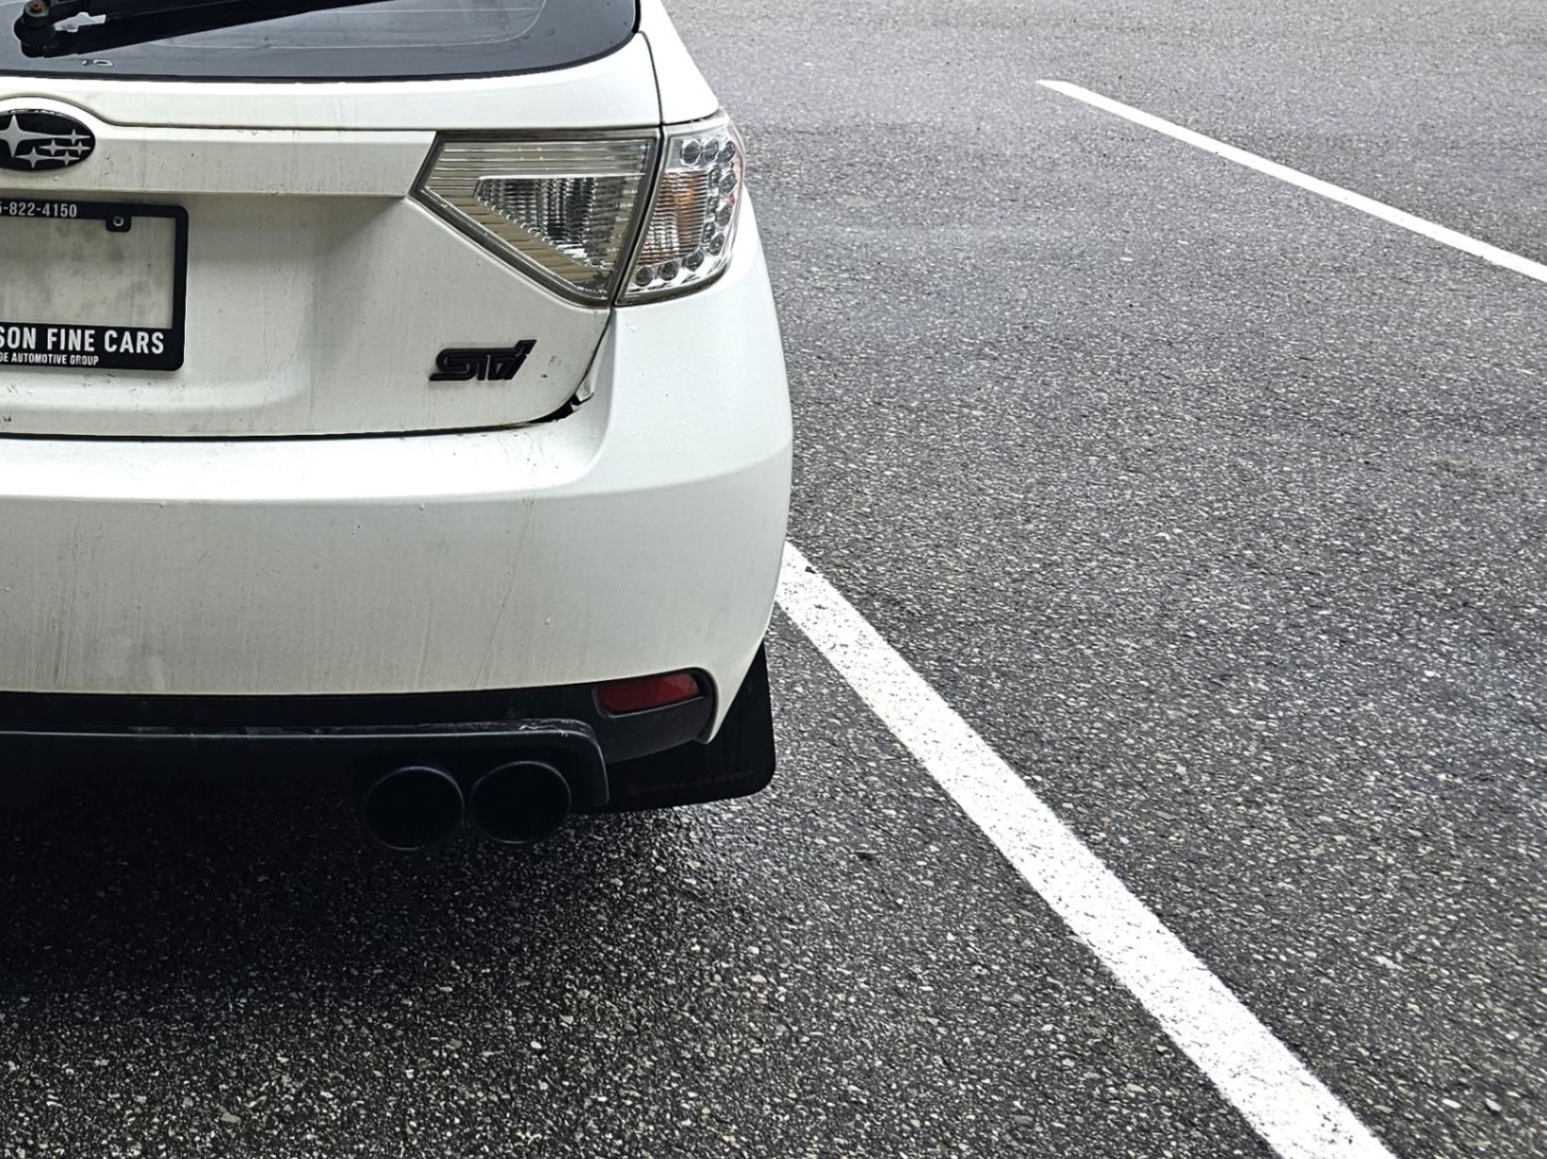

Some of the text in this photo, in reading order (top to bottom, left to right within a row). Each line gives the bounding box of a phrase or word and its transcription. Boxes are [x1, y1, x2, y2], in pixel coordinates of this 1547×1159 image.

[47, 328, 95, 352] FINE
[104, 330, 165, 355] CARS
[11, 352, 67, 366] AUTOMOTIVE
[69, 354, 99, 367] GROUP
